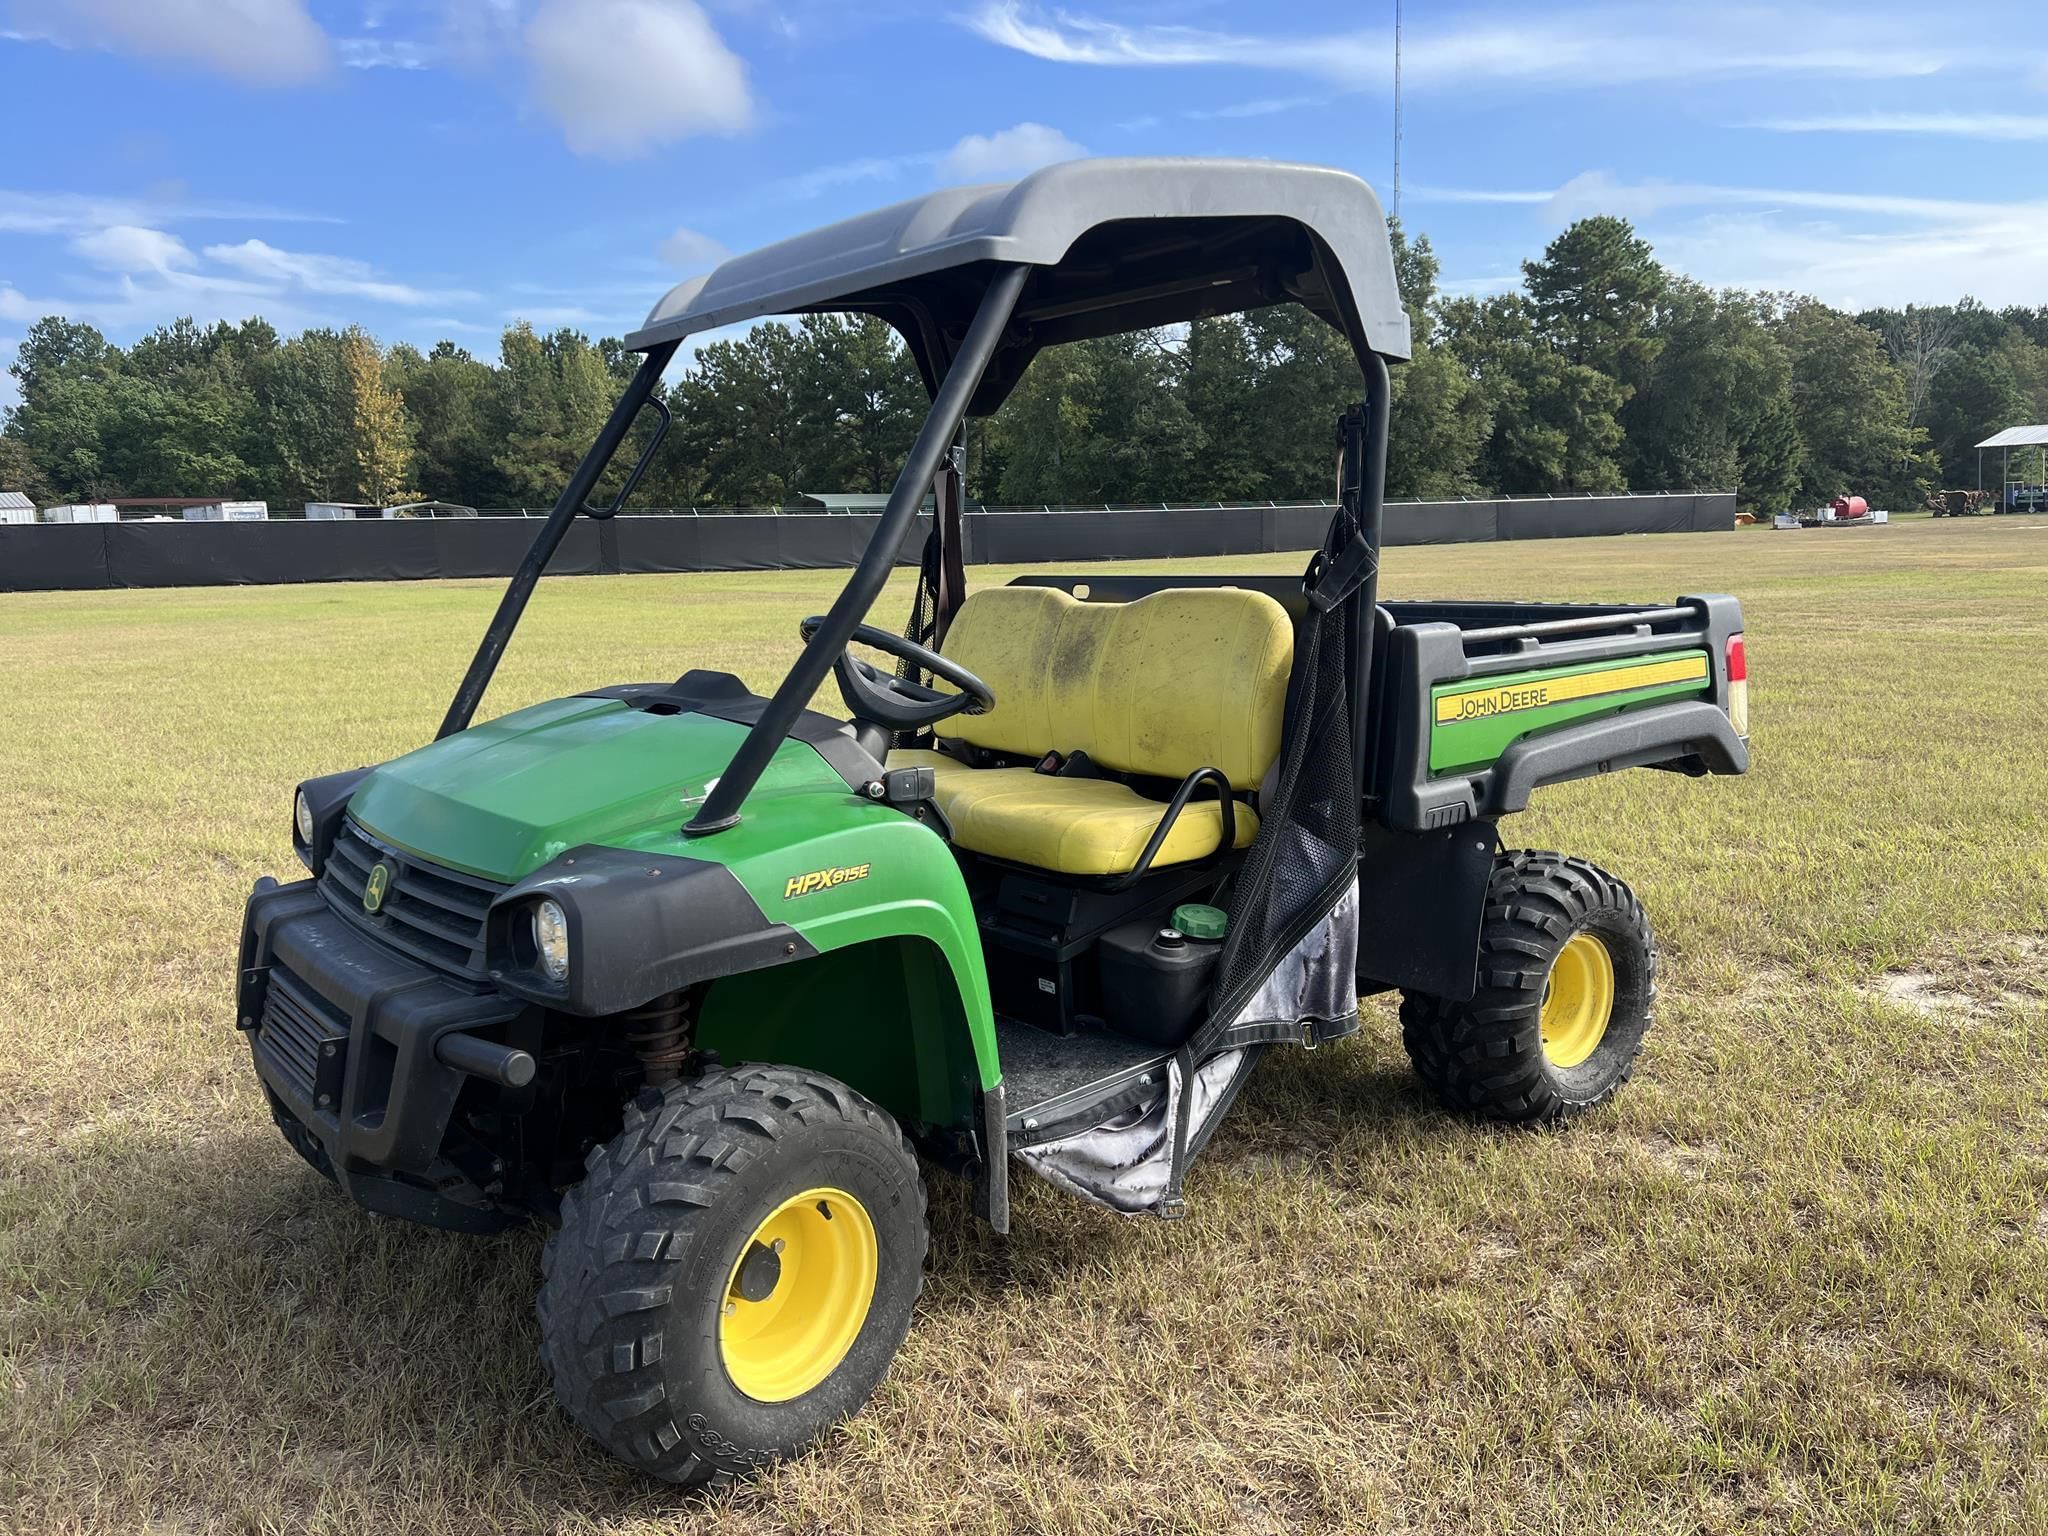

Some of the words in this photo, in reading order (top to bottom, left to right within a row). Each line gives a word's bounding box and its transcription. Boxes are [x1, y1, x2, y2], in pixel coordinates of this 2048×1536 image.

[1456, 696, 1497, 718] JOHN
[1500, 687, 1548, 710] DEERE
[783, 862, 871, 900] HPX815E
